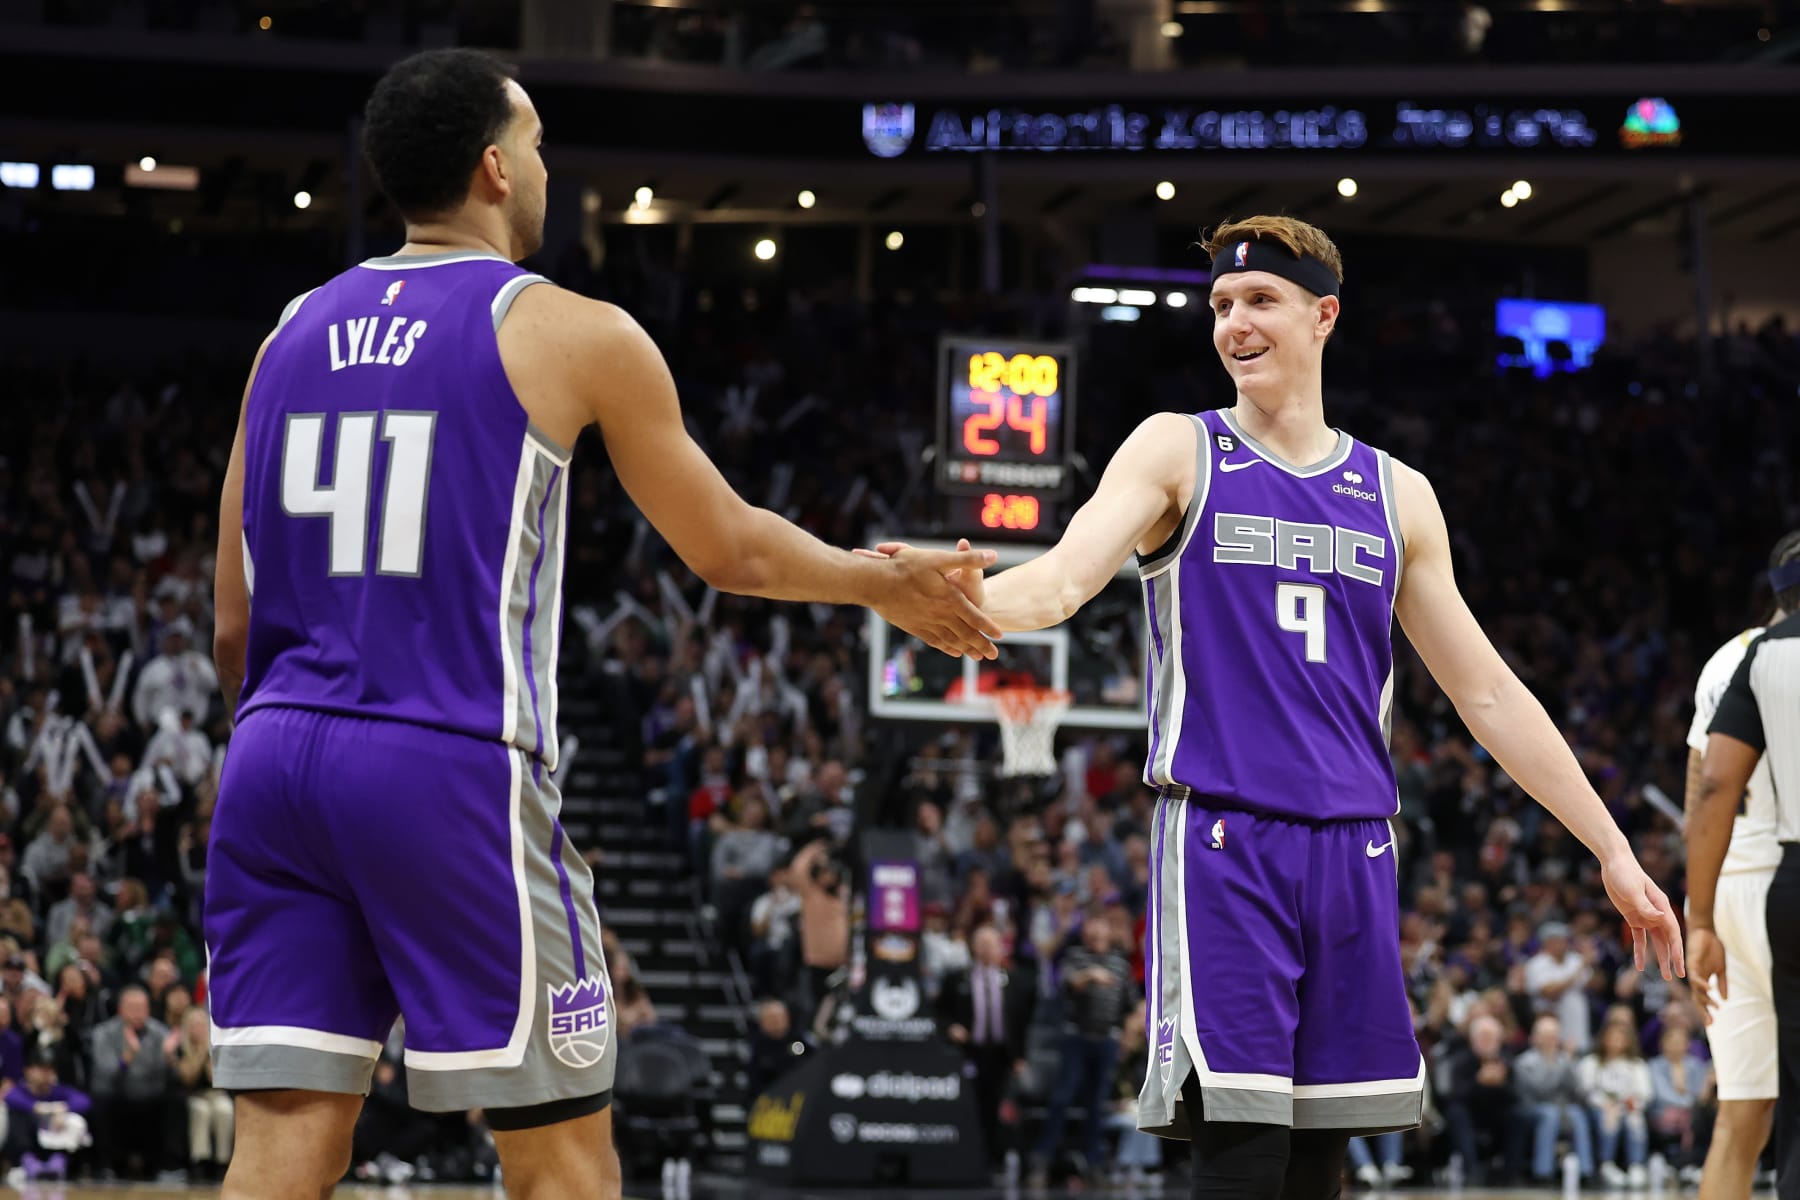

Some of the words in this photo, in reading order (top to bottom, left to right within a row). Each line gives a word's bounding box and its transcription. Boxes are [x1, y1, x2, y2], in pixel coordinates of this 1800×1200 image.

[328, 316, 428, 372] LYLES
[968, 351, 1059, 397] 12:00
[963, 389, 1048, 455] 24
[1217, 435, 1235, 452] 6
[280, 409, 439, 578] 41
[1331, 482, 1377, 503] dialpad
[1213, 512, 1386, 587] SAC
[1275, 581, 1328, 664] 9
[551, 1005, 608, 1036] SAC
